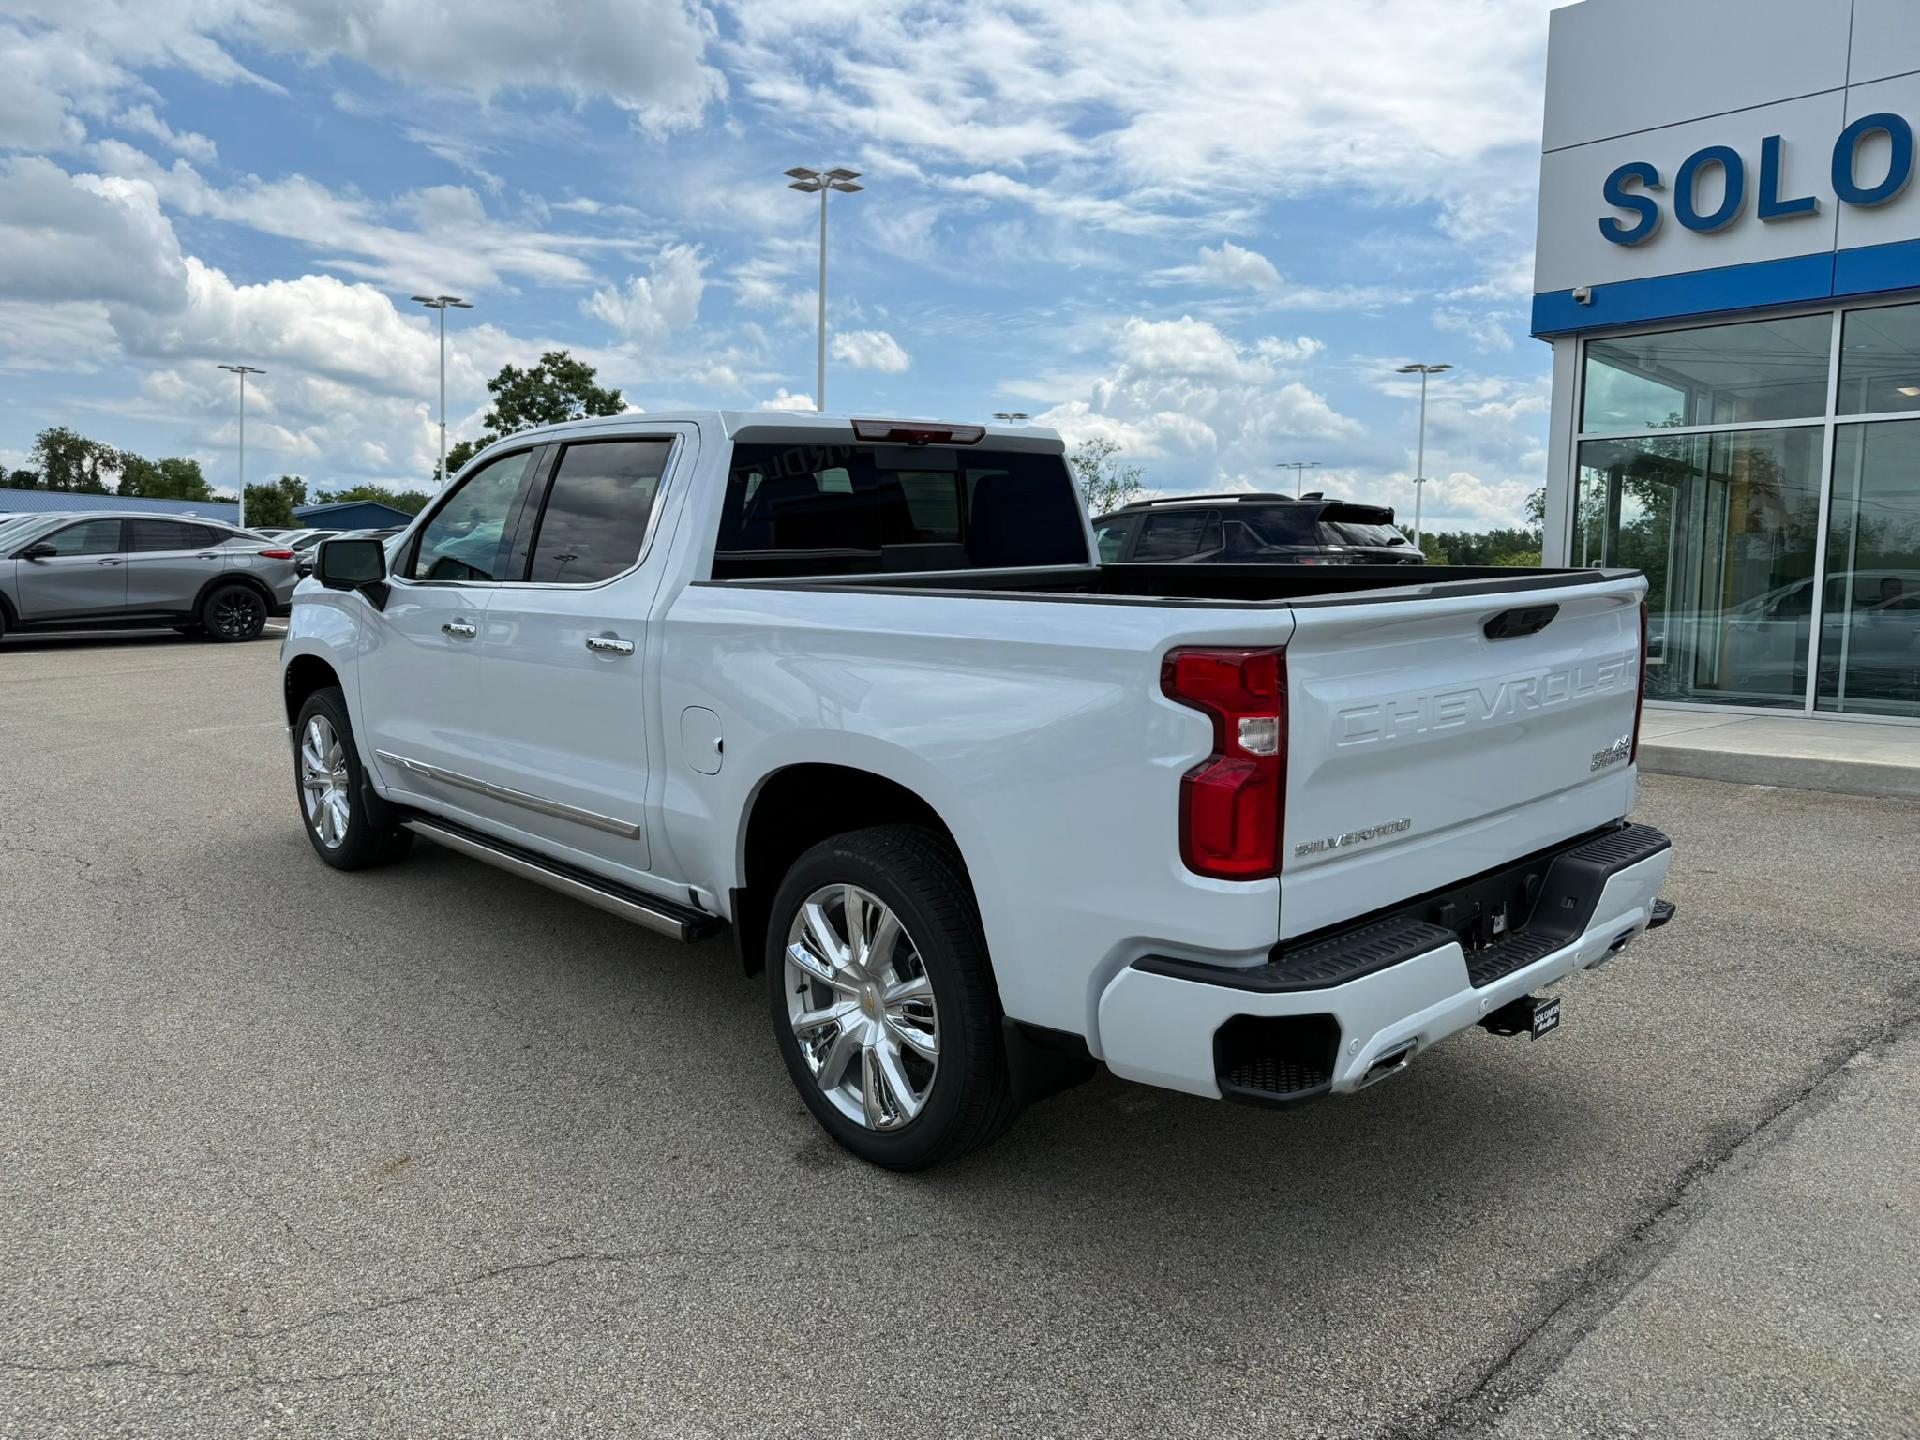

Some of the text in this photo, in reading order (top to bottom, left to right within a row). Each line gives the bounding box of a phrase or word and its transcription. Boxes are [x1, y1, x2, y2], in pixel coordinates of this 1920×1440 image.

[1598, 112, 1914, 246] SOLO
[1335, 656, 1636, 747] CHEVROLET
[1295, 818, 1411, 857] SILVERADO
[1535, 1004, 1560, 1025] SOLOMON
